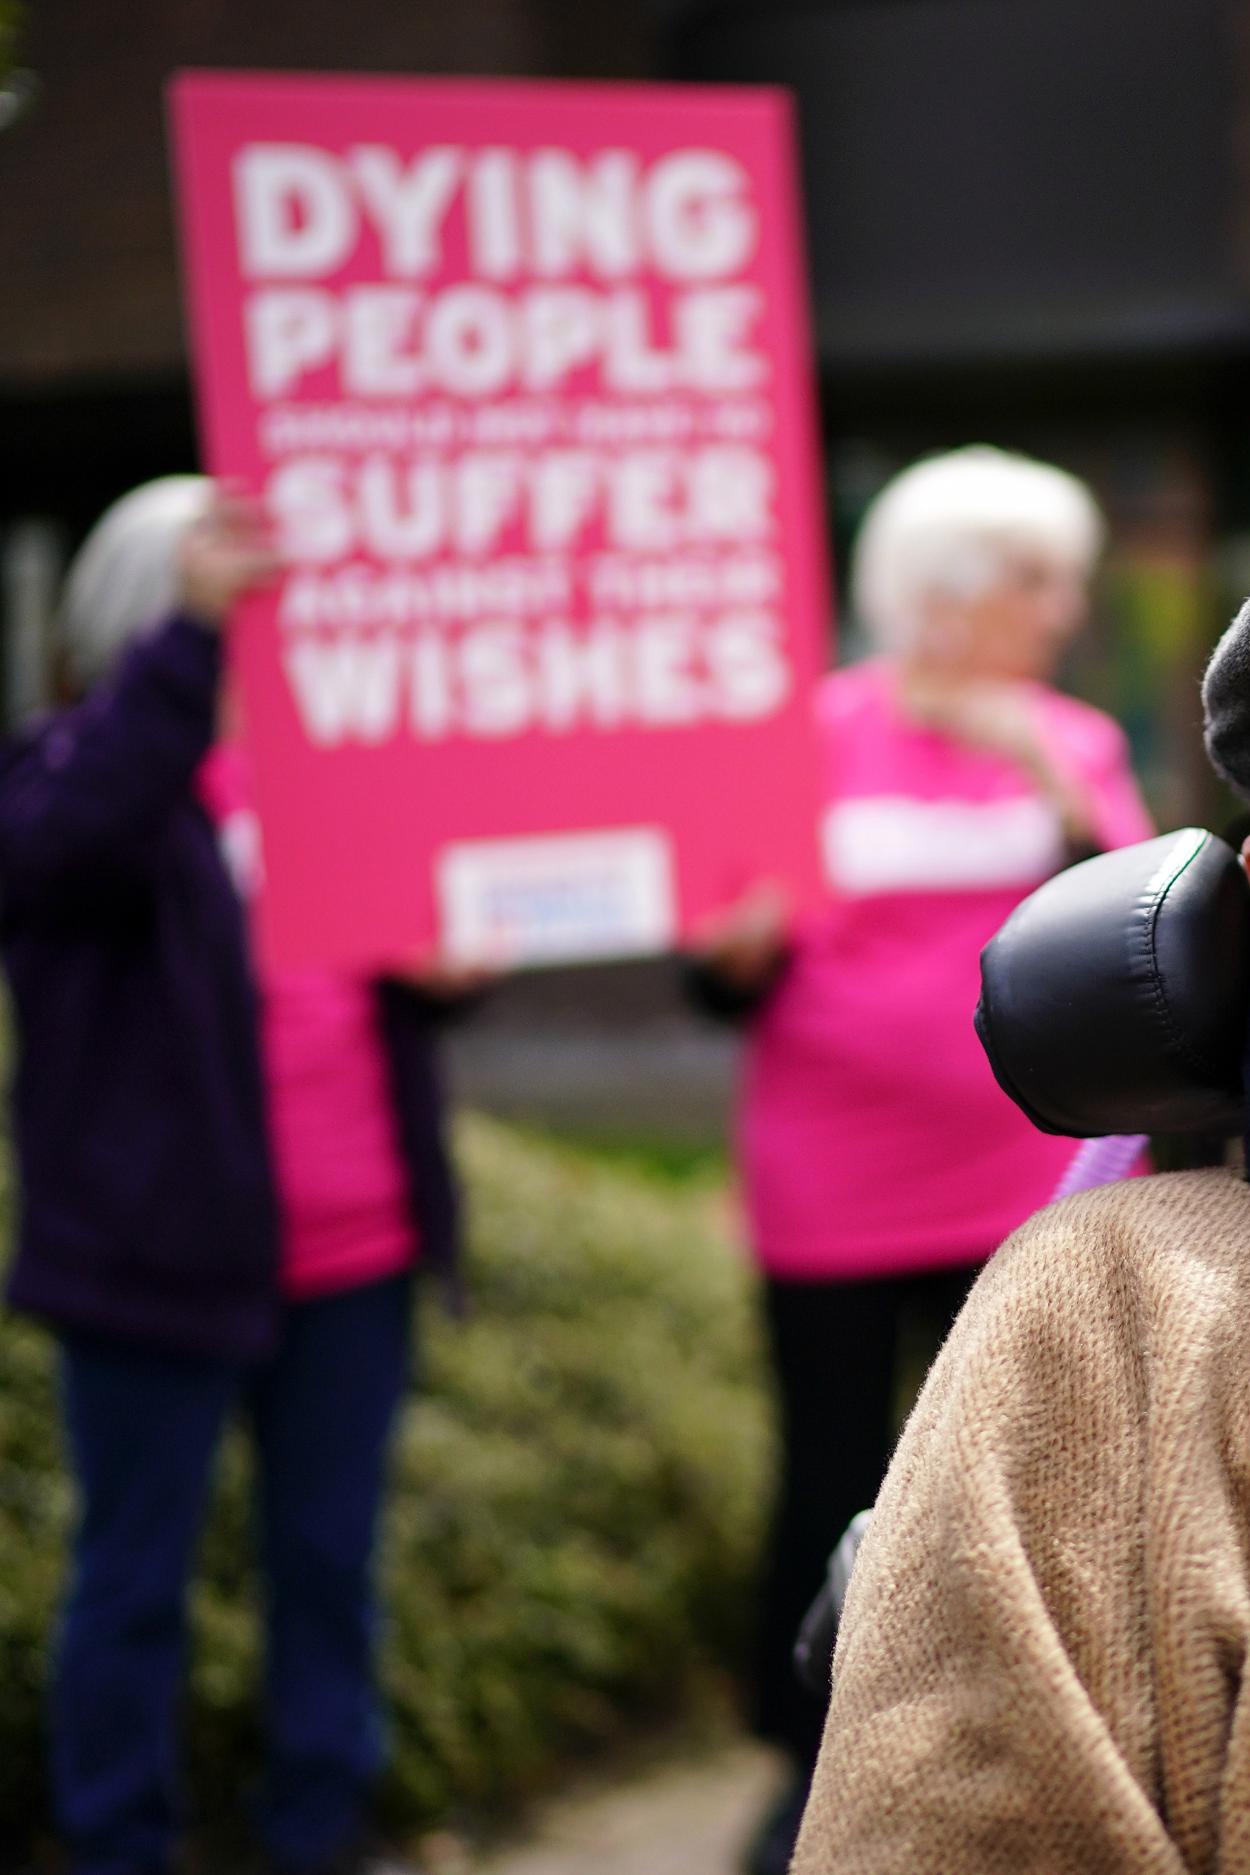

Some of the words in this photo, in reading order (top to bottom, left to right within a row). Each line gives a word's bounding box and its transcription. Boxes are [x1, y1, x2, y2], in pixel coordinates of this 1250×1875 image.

[233, 143, 757, 281] DYING
[244, 284, 768, 397] PEOPLE
[267, 444, 776, 562] SUFFER
[284, 612, 790, 746] WISHES
